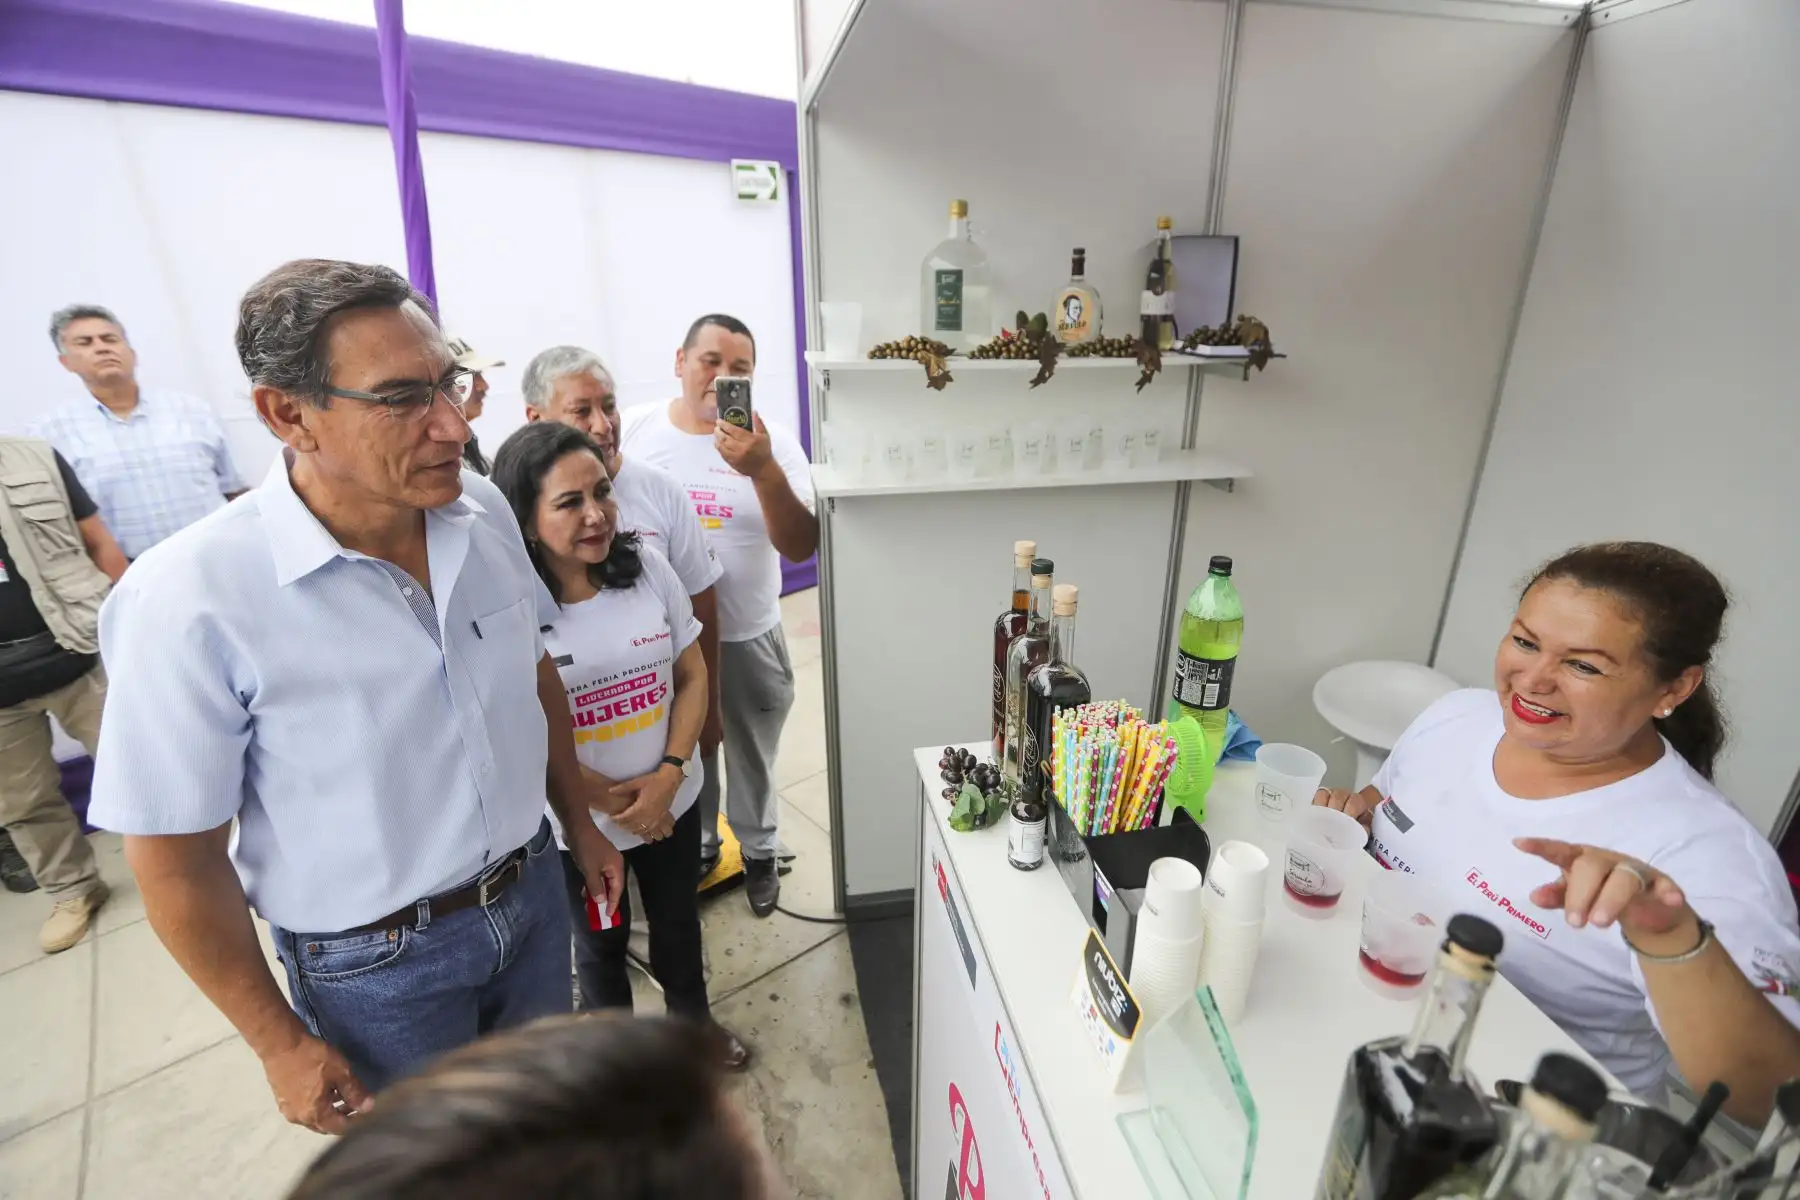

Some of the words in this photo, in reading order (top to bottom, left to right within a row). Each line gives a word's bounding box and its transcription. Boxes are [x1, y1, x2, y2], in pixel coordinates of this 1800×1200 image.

[592, 674, 619, 687] FERIA
[635, 674, 654, 688] POR
[1498, 897, 1546, 935] PRIMERO
